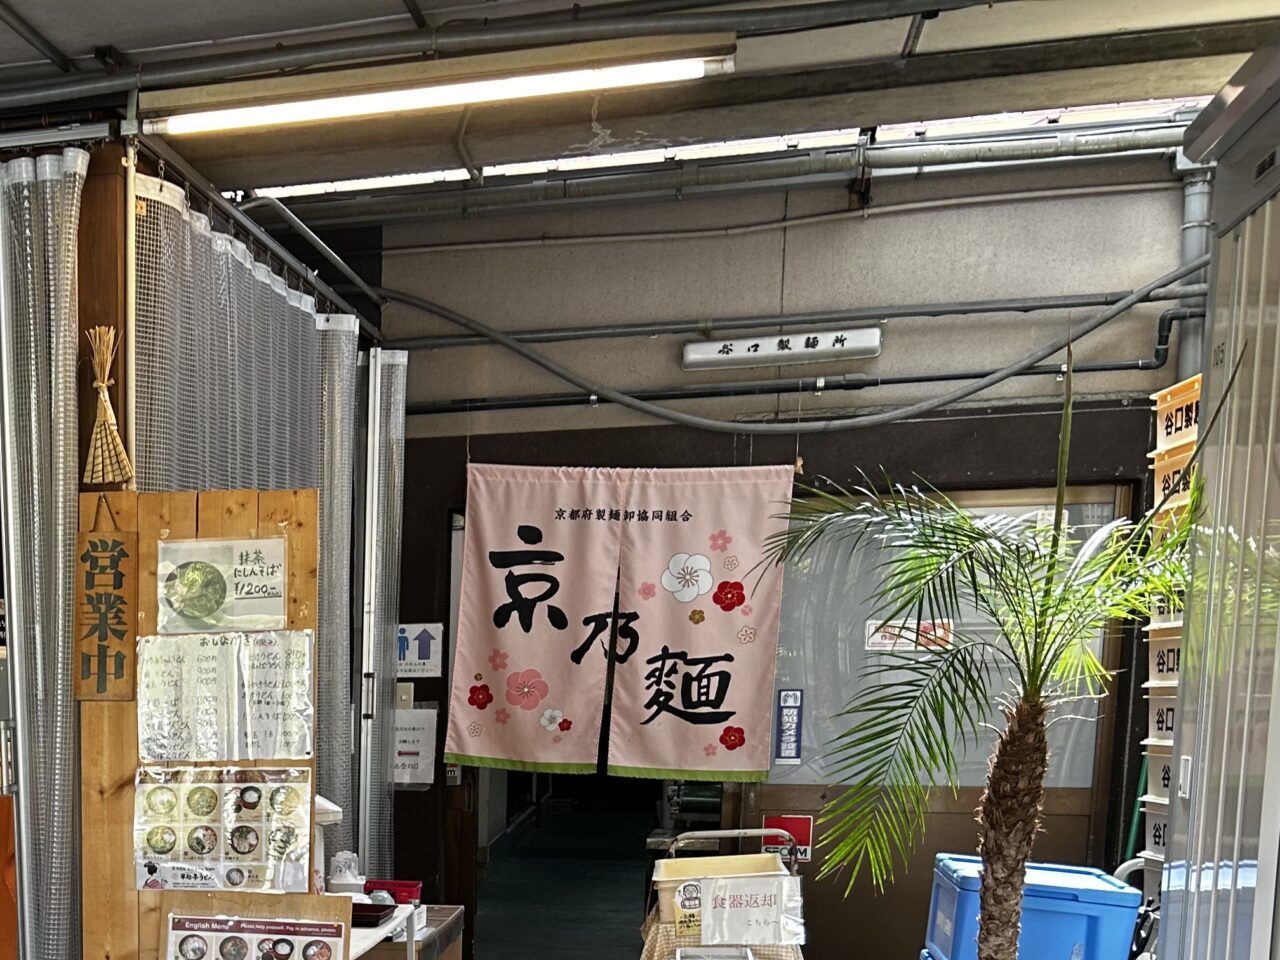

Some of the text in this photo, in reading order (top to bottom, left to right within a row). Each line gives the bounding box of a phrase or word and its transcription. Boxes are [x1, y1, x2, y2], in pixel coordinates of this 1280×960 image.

[238, 549, 267, 566] 抹茶
[234, 564, 282, 578] にしんそば
[80, 538, 130, 694] 営業中
[712, 893, 777, 909] 食器返却
